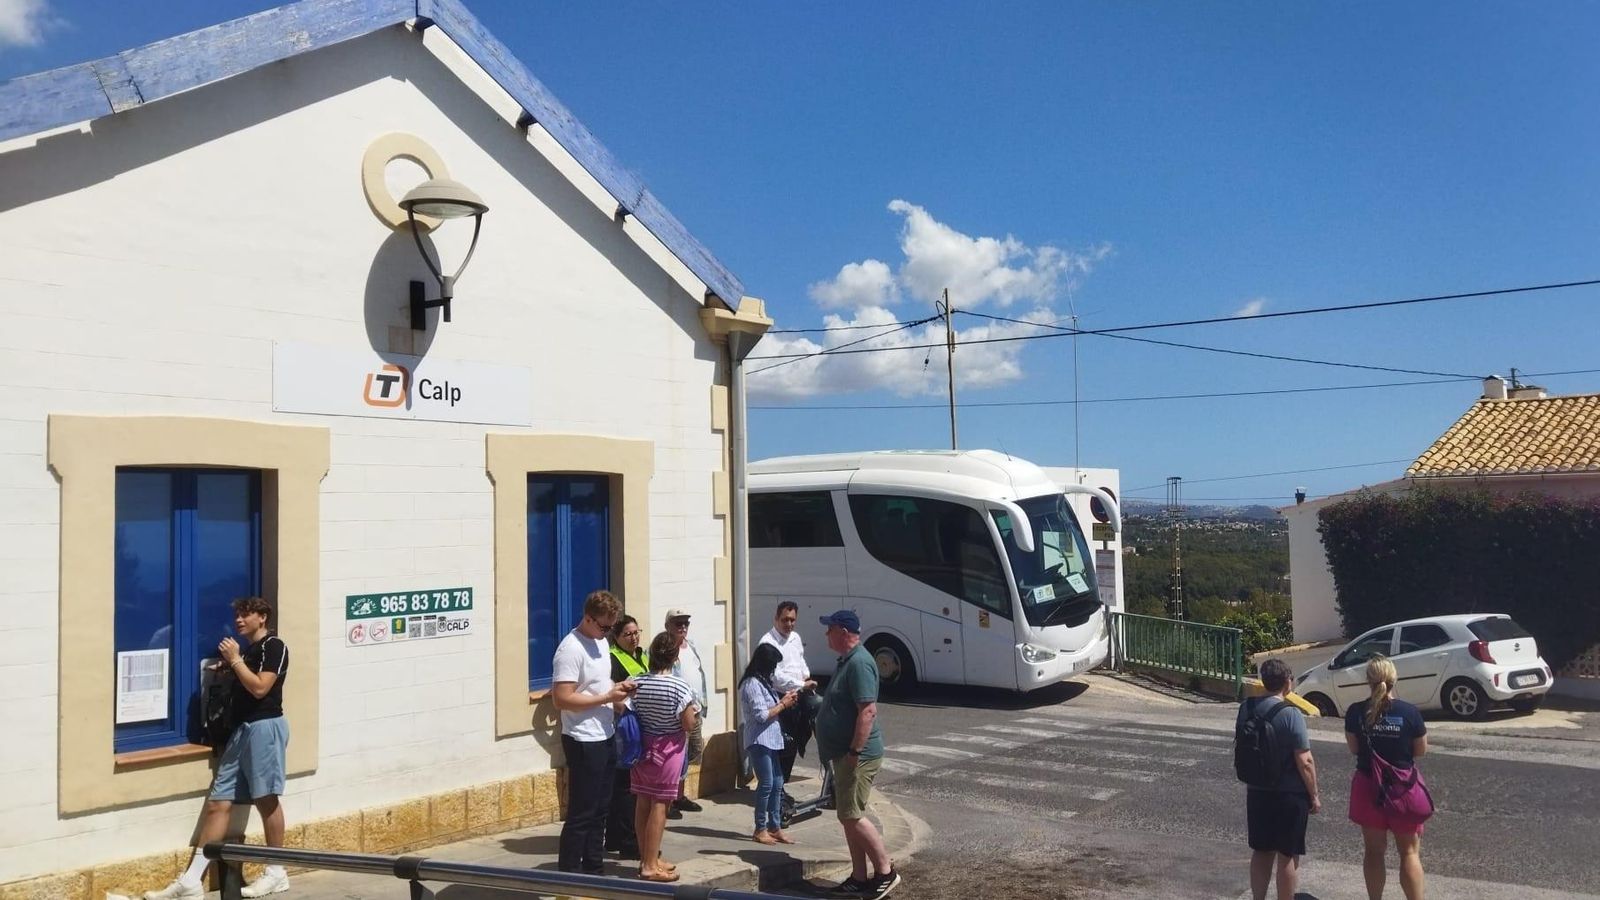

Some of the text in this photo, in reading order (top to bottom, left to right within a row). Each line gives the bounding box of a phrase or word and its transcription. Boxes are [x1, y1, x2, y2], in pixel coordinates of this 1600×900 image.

[418, 379, 461, 407] Calp
[380, 590, 470, 614] 965 83 78 78
[447, 621, 470, 631] CALP
